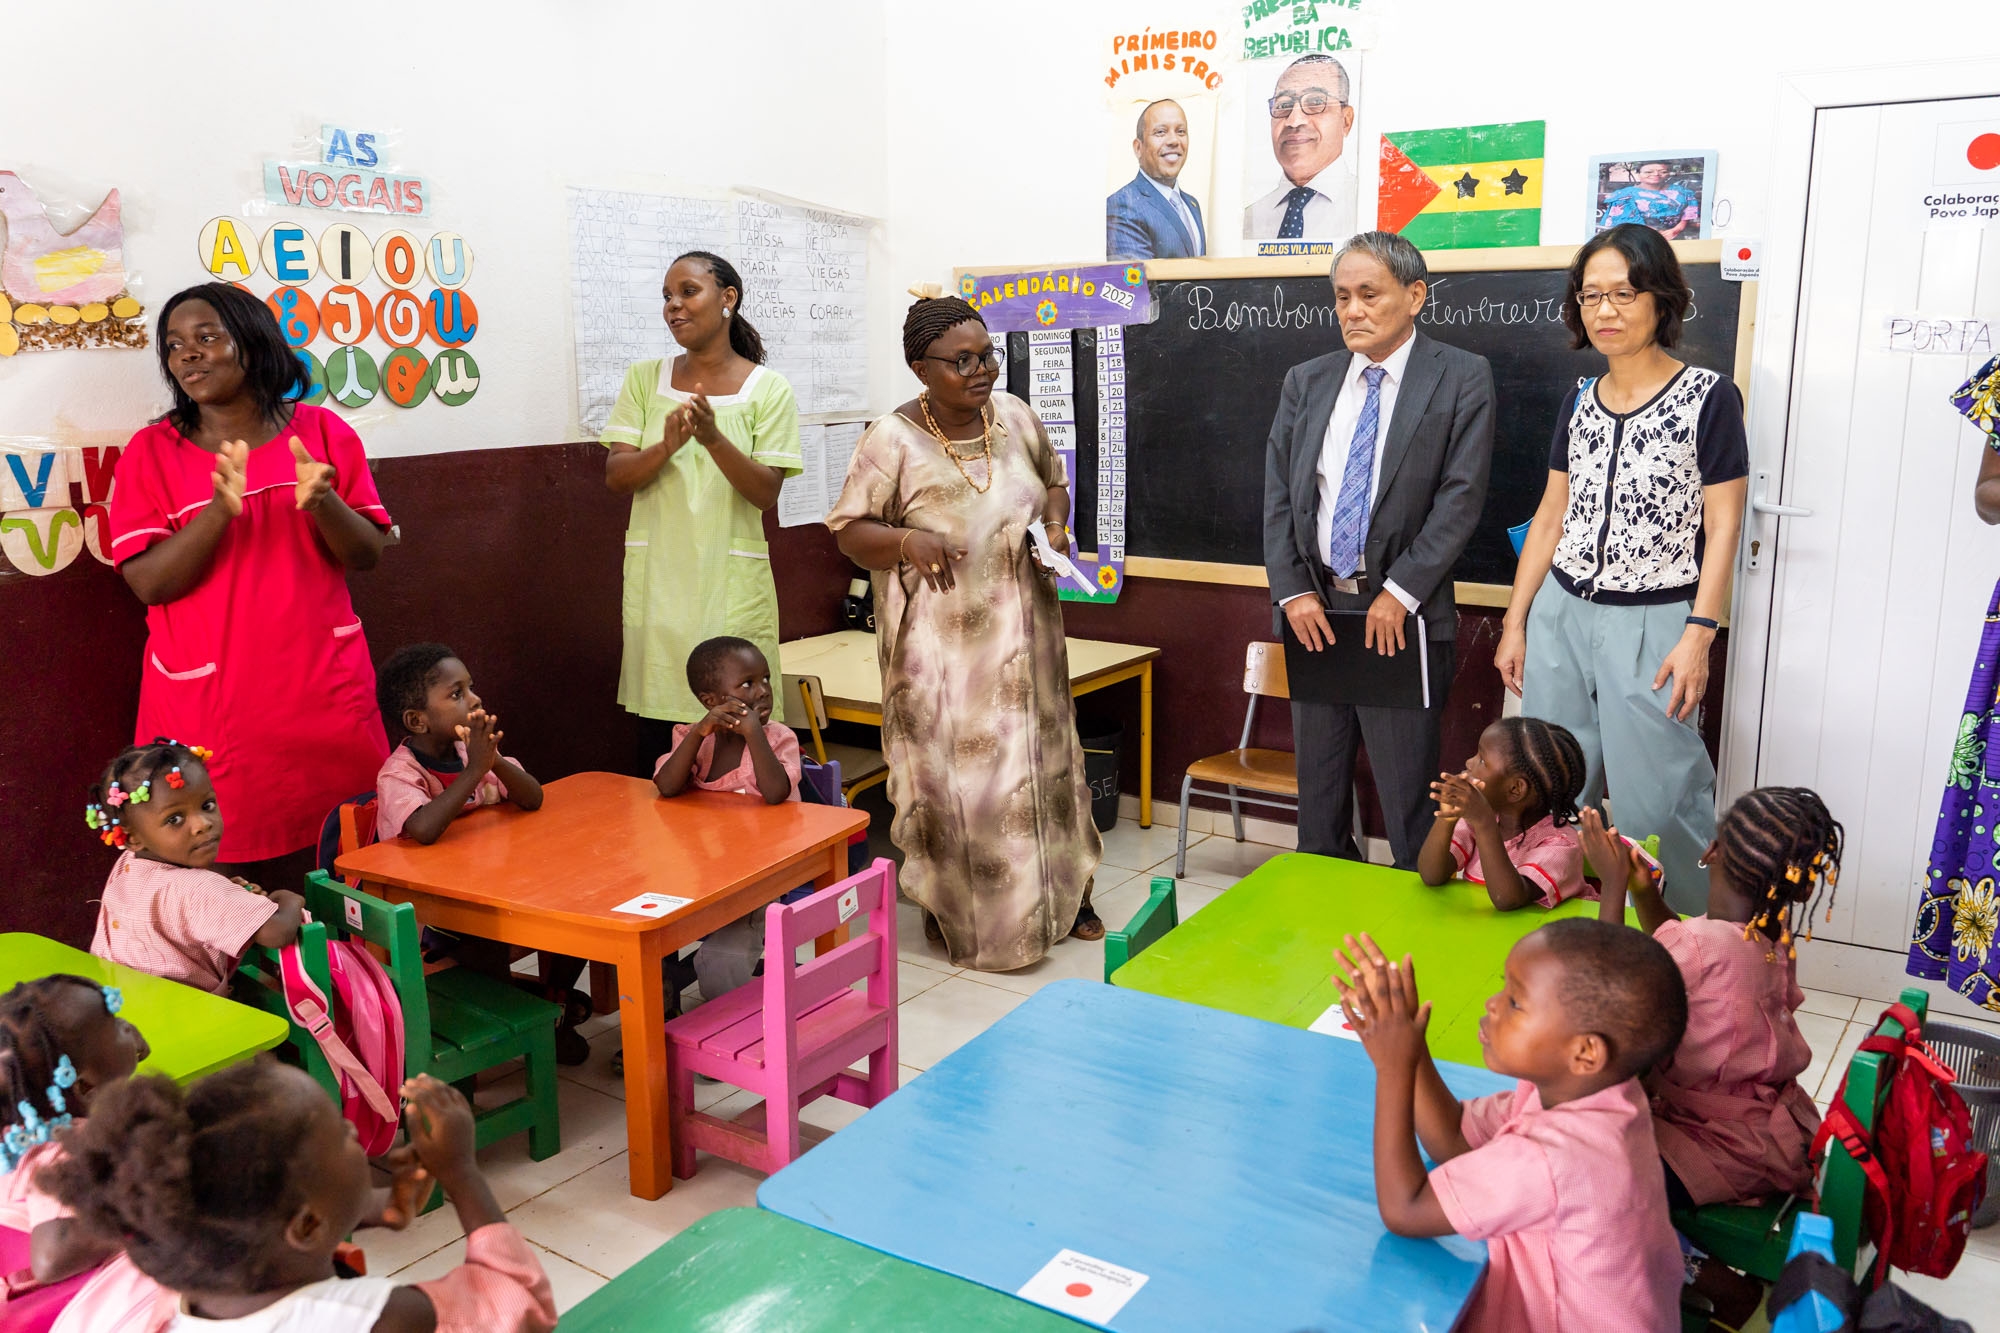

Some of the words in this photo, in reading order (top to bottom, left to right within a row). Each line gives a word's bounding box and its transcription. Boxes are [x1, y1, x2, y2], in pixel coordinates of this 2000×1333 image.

[1244, 25, 1352, 58] REPÚBLICA
[1104, 53, 1223, 90] MINISTRO
[326, 128, 378, 167] AS
[278, 166, 423, 214] VOGAIS
[738, 200, 783, 219] IDELSON
[1930, 207, 1967, 219] Povo
[739, 230, 784, 248] LARISSA
[211, 220, 251, 275] A
[274, 229, 309, 280] E
[385, 236, 415, 284] O
[432, 239, 464, 285] U
[1258, 244, 1288, 254] CARLOS
[1291, 244, 1309, 254] VILA
[1310, 244, 1332, 254] NOVA
[741, 260, 778, 275] MARIA
[807, 265, 850, 279] VIEGAS
[811, 279, 845, 292] LIMA
[743, 288, 784, 304] MISAEL
[1102, 285, 1134, 308] 2022
[742, 304, 796, 319] MIQUEIAS
[1032, 331, 1072, 341] DOMINGO
[1099, 332, 1103, 340] 1
[1109, 327, 1119, 337] 16
[1888, 318, 1992, 353] PORTA
[1034, 346, 1071, 356] SEGUNDA
[1099, 346, 1105, 355] 2
[1110, 343, 1120, 353] 17
[1043, 358, 1065, 368] FEIRA
[1099, 361, 1105, 370] 3
[1111, 358, 1122, 367] 18
[1036, 372, 1061, 382] TERÇA
[1099, 374, 1106, 383] 4
[1112, 373, 1123, 382] 19
[1040, 385, 1062, 394] FEIRA
[1099, 389, 1105, 399] 5
[1111, 387, 1123, 396] 20
[1040, 399, 1066, 408] QUATA
[1112, 402, 1123, 411] 21
[1102, 404, 1108, 413] 6
[1040, 412, 1063, 421] FEIRA
[1112, 416, 1123, 426] 22
[1101, 418, 1108, 427] 7
[1100, 432, 1107, 441] 8
[1111, 431, 1122, 440] 23
[1100, 446, 1106, 455] 9
[1112, 443, 1124, 454] 24
[1100, 459, 1111, 468] 10
[1114, 459, 1125, 468] 25
[5, 452, 56, 508] V
[1099, 474, 1110, 483] 11
[1114, 474, 1125, 483] 26
[1099, 488, 1110, 497] 12
[1113, 490, 1124, 498] 27
[1098, 503, 1109, 512] 13
[1112, 504, 1123, 513] 28
[1098, 517, 1110, 527] 14
[1112, 519, 1123, 528] 29
[1099, 532, 1110, 542] 15
[1112, 534, 1124, 543] 30
[1112, 550, 1123, 559] 31
